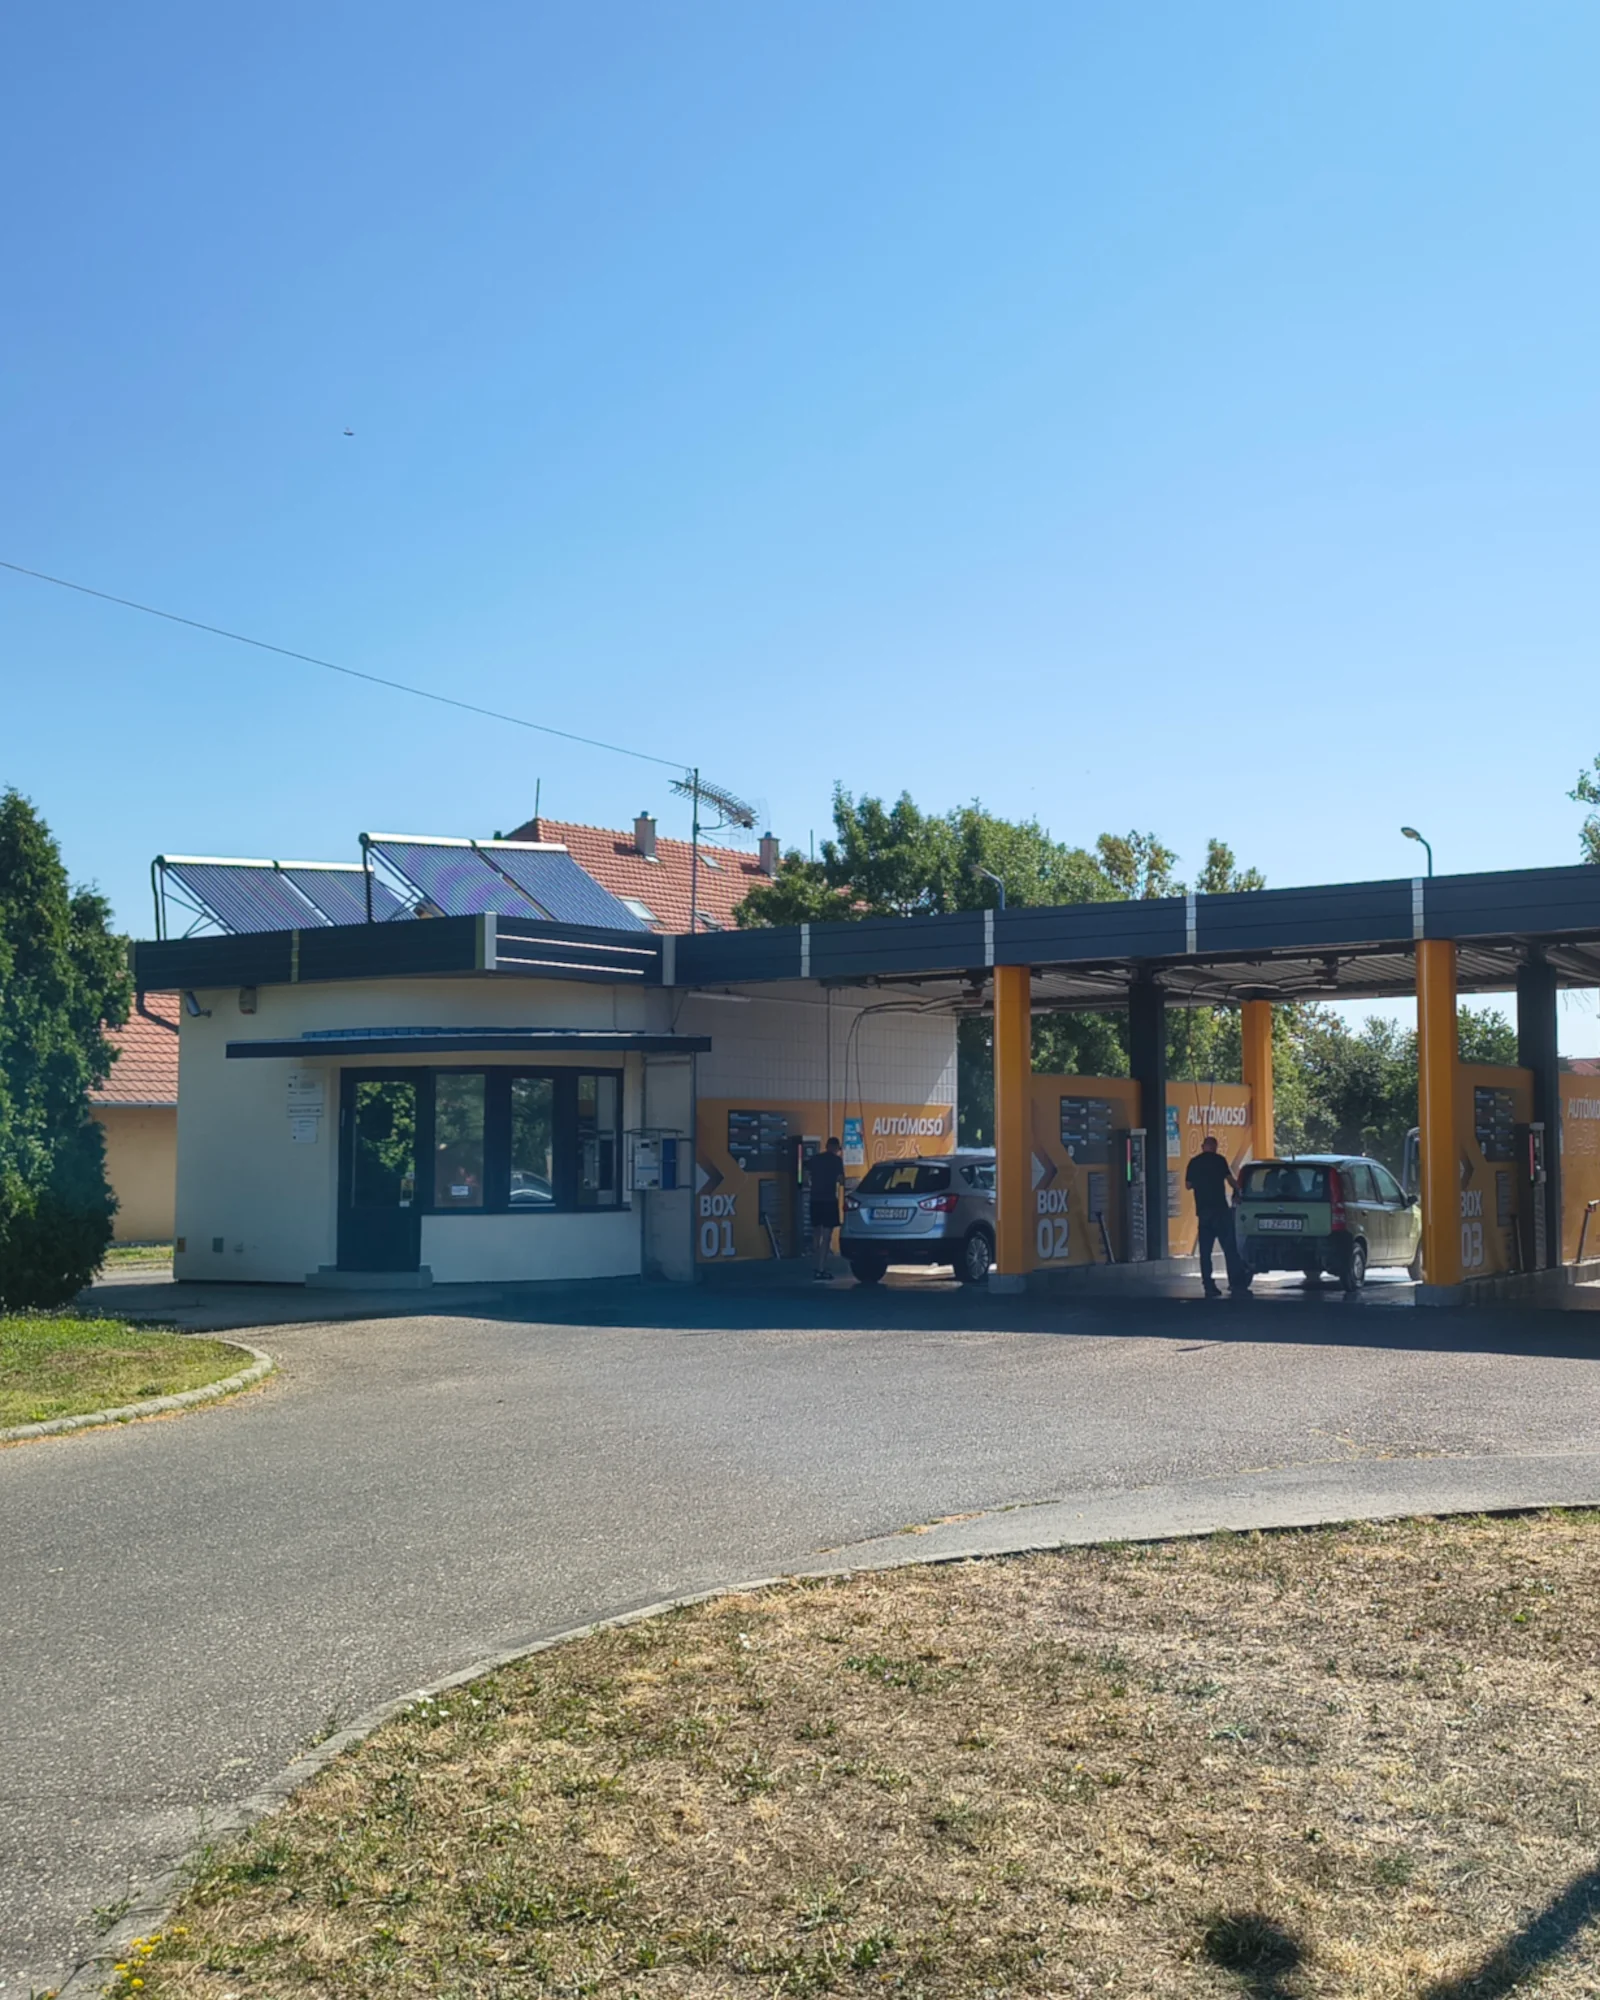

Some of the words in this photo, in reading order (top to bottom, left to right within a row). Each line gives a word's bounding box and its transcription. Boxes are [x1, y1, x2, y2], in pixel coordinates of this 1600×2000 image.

[872, 1112, 944, 1136] AUTÓMOSÓ
[1187, 1101, 1246, 1126] AUTÓMOSÓ
[700, 1194, 736, 1217] BOX
[1037, 1190, 1068, 1214] BOX
[701, 1221, 736, 1258] 01
[1037, 1218, 1069, 1258] 02
[1462, 1222, 1483, 1267] 03
